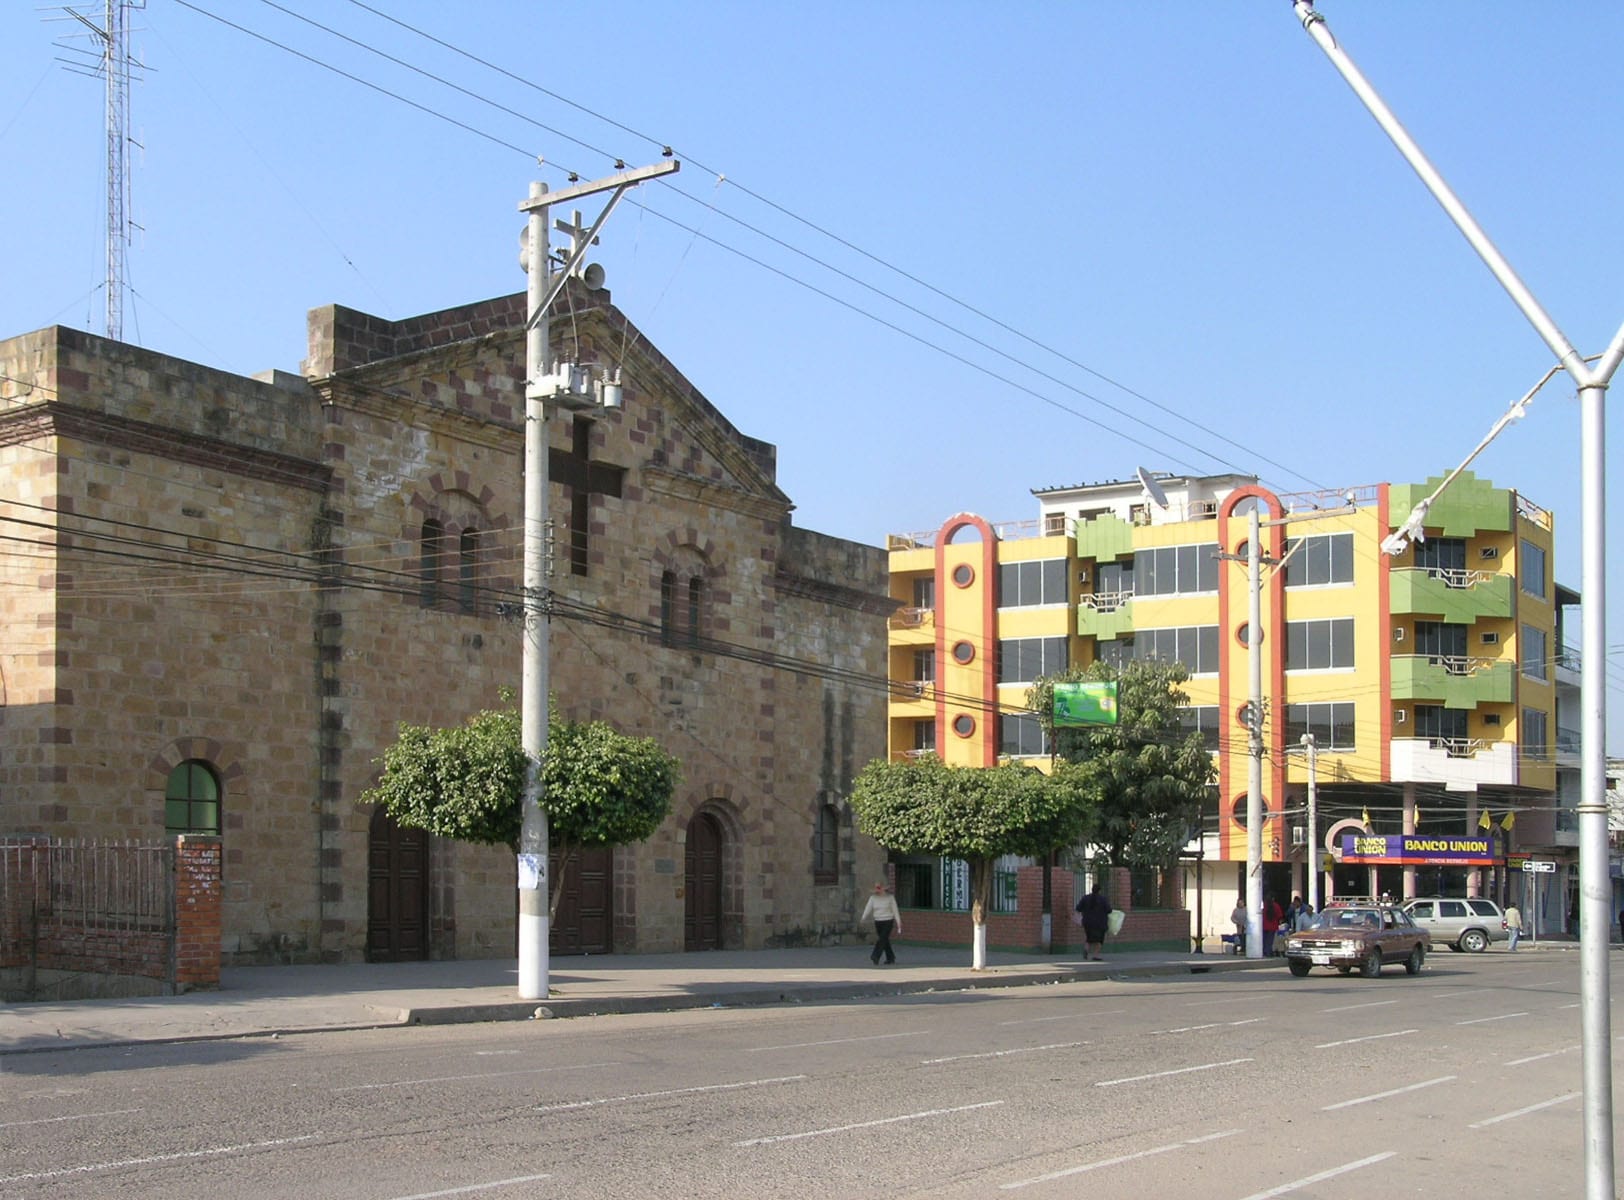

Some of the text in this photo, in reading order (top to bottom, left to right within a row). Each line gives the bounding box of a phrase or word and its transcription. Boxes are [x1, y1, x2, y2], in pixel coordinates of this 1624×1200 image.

[1354, 837, 1386, 846] BANCO
[1404, 840, 1487, 852] BANCO UNION
[1354, 845, 1386, 854] UNION
